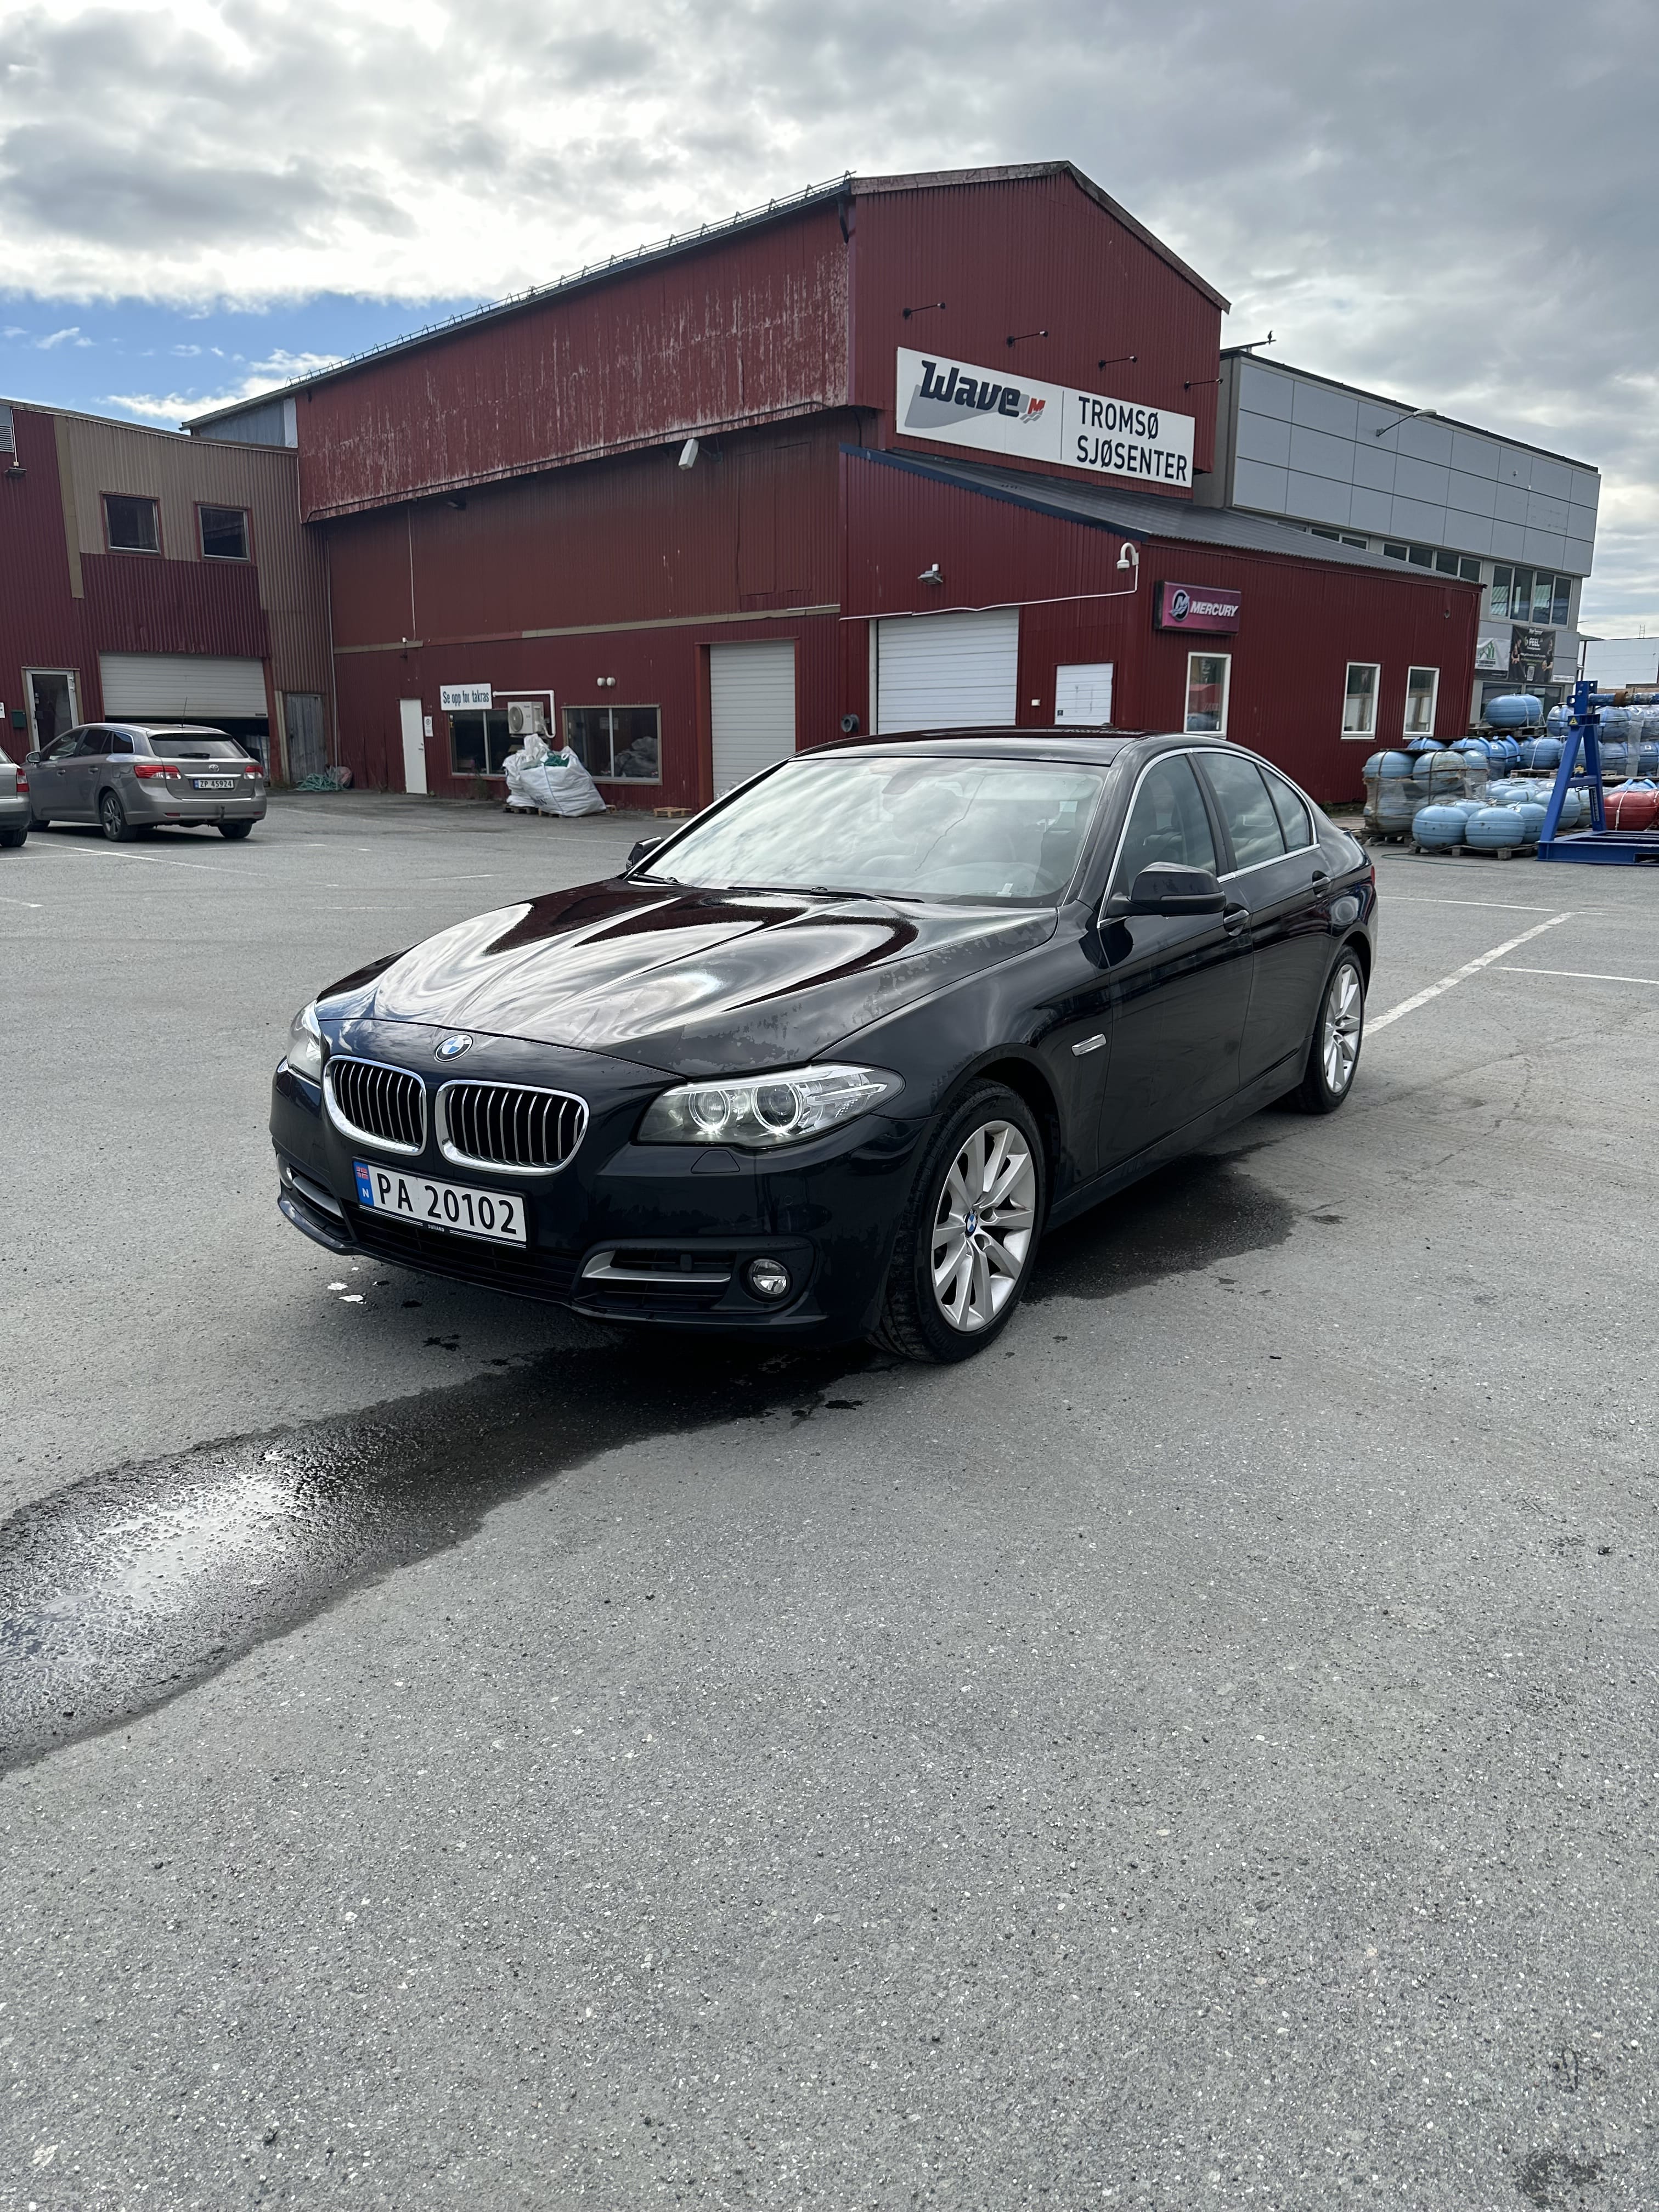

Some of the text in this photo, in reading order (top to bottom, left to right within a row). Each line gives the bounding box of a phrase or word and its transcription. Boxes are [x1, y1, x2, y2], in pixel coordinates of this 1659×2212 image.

[919, 359, 1021, 417] Wave
[1079, 396, 1159, 439] TROMSØ
[1076, 435, 1187, 481] SJØSENTER
[1189, 601, 1238, 617] MERCURY
[443, 691, 450, 704] Se
[452, 693, 461, 707] opp
[472, 689, 489, 703] takras
[362, 1188, 369, 1198] N
[377, 1172, 517, 1235] PA 20102
